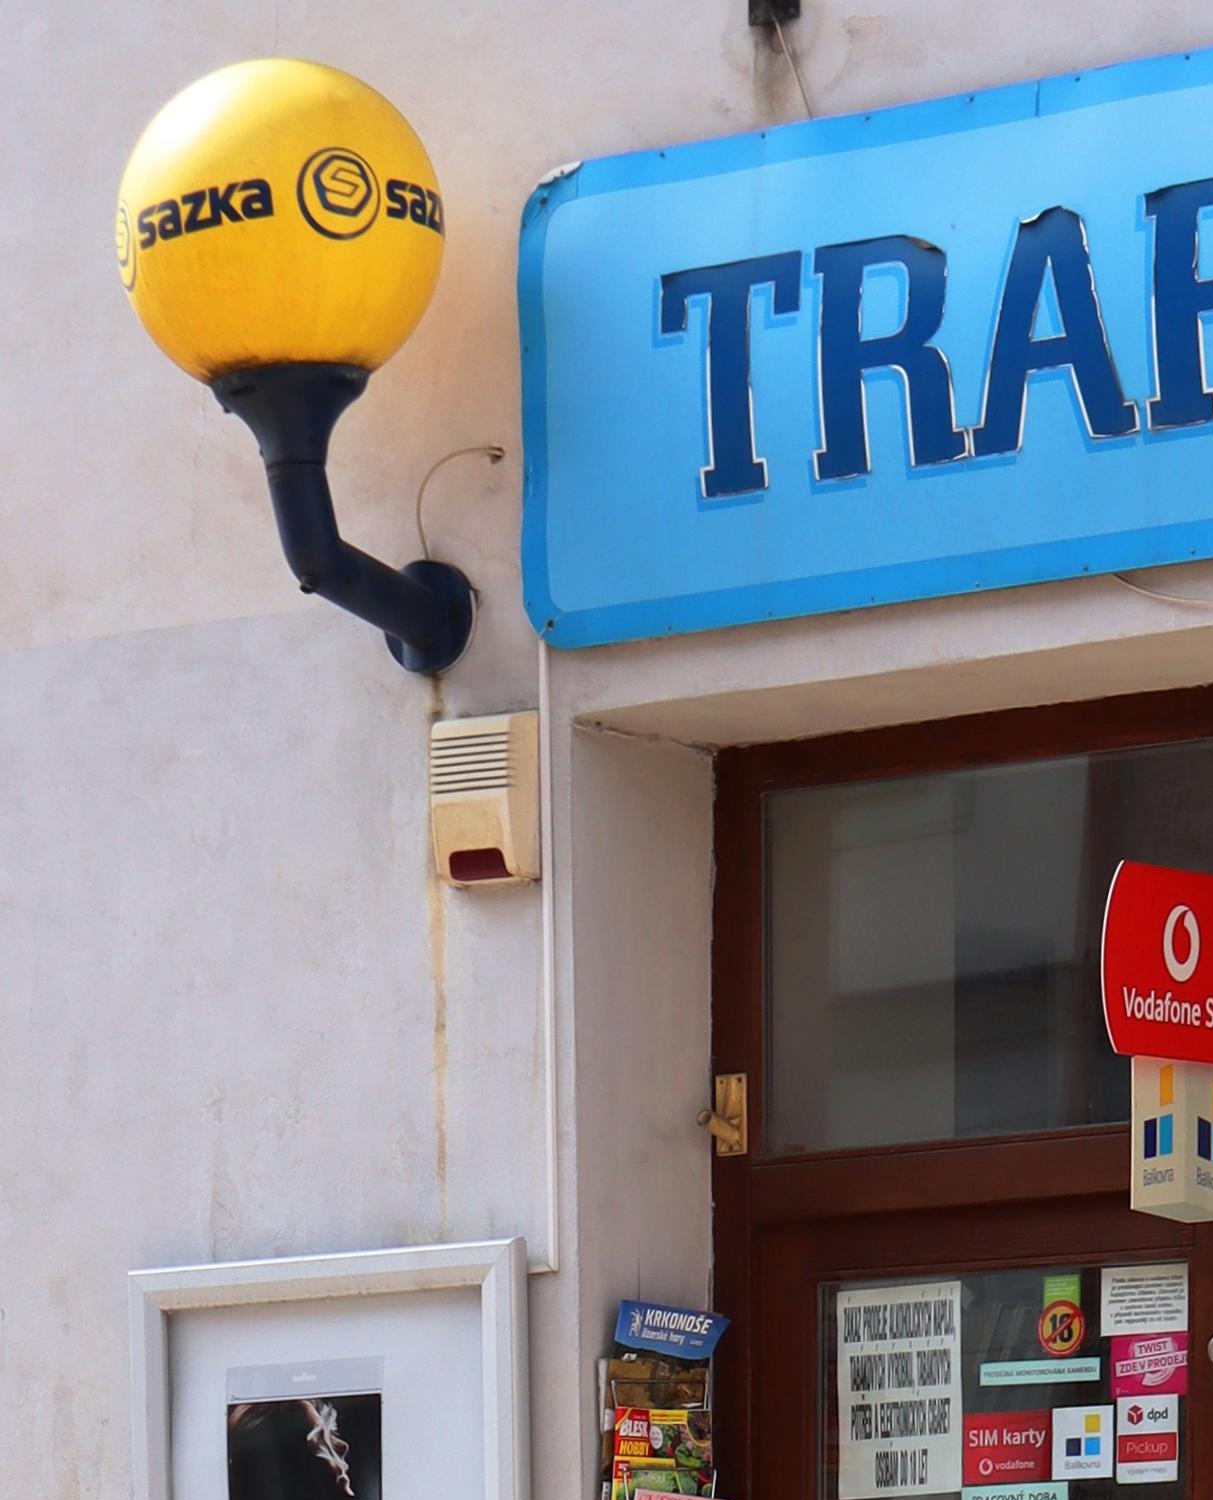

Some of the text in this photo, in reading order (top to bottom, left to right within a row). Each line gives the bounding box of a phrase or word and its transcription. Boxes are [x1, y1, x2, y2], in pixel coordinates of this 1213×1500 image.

[1122, 986, 1201, 1027] Vodafone
[644, 1308, 713, 1335] KRKONOŠE
[1049, 1312, 1074, 1345] 18
[1138, 1340, 1168, 1354] TWIST
[1120, 1362, 1138, 1374] ZDE
[1139, 1361, 1146, 1370] V
[1147, 1407, 1168, 1422] dpd
[620, 1418, 648, 1438] BLESK
[968, 1427, 1046, 1449] SIM karty
[620, 1440, 649, 1456] HOBBY
[1126, 1441, 1168, 1455] Pickup
[995, 1459, 1035, 1470] vodafone
